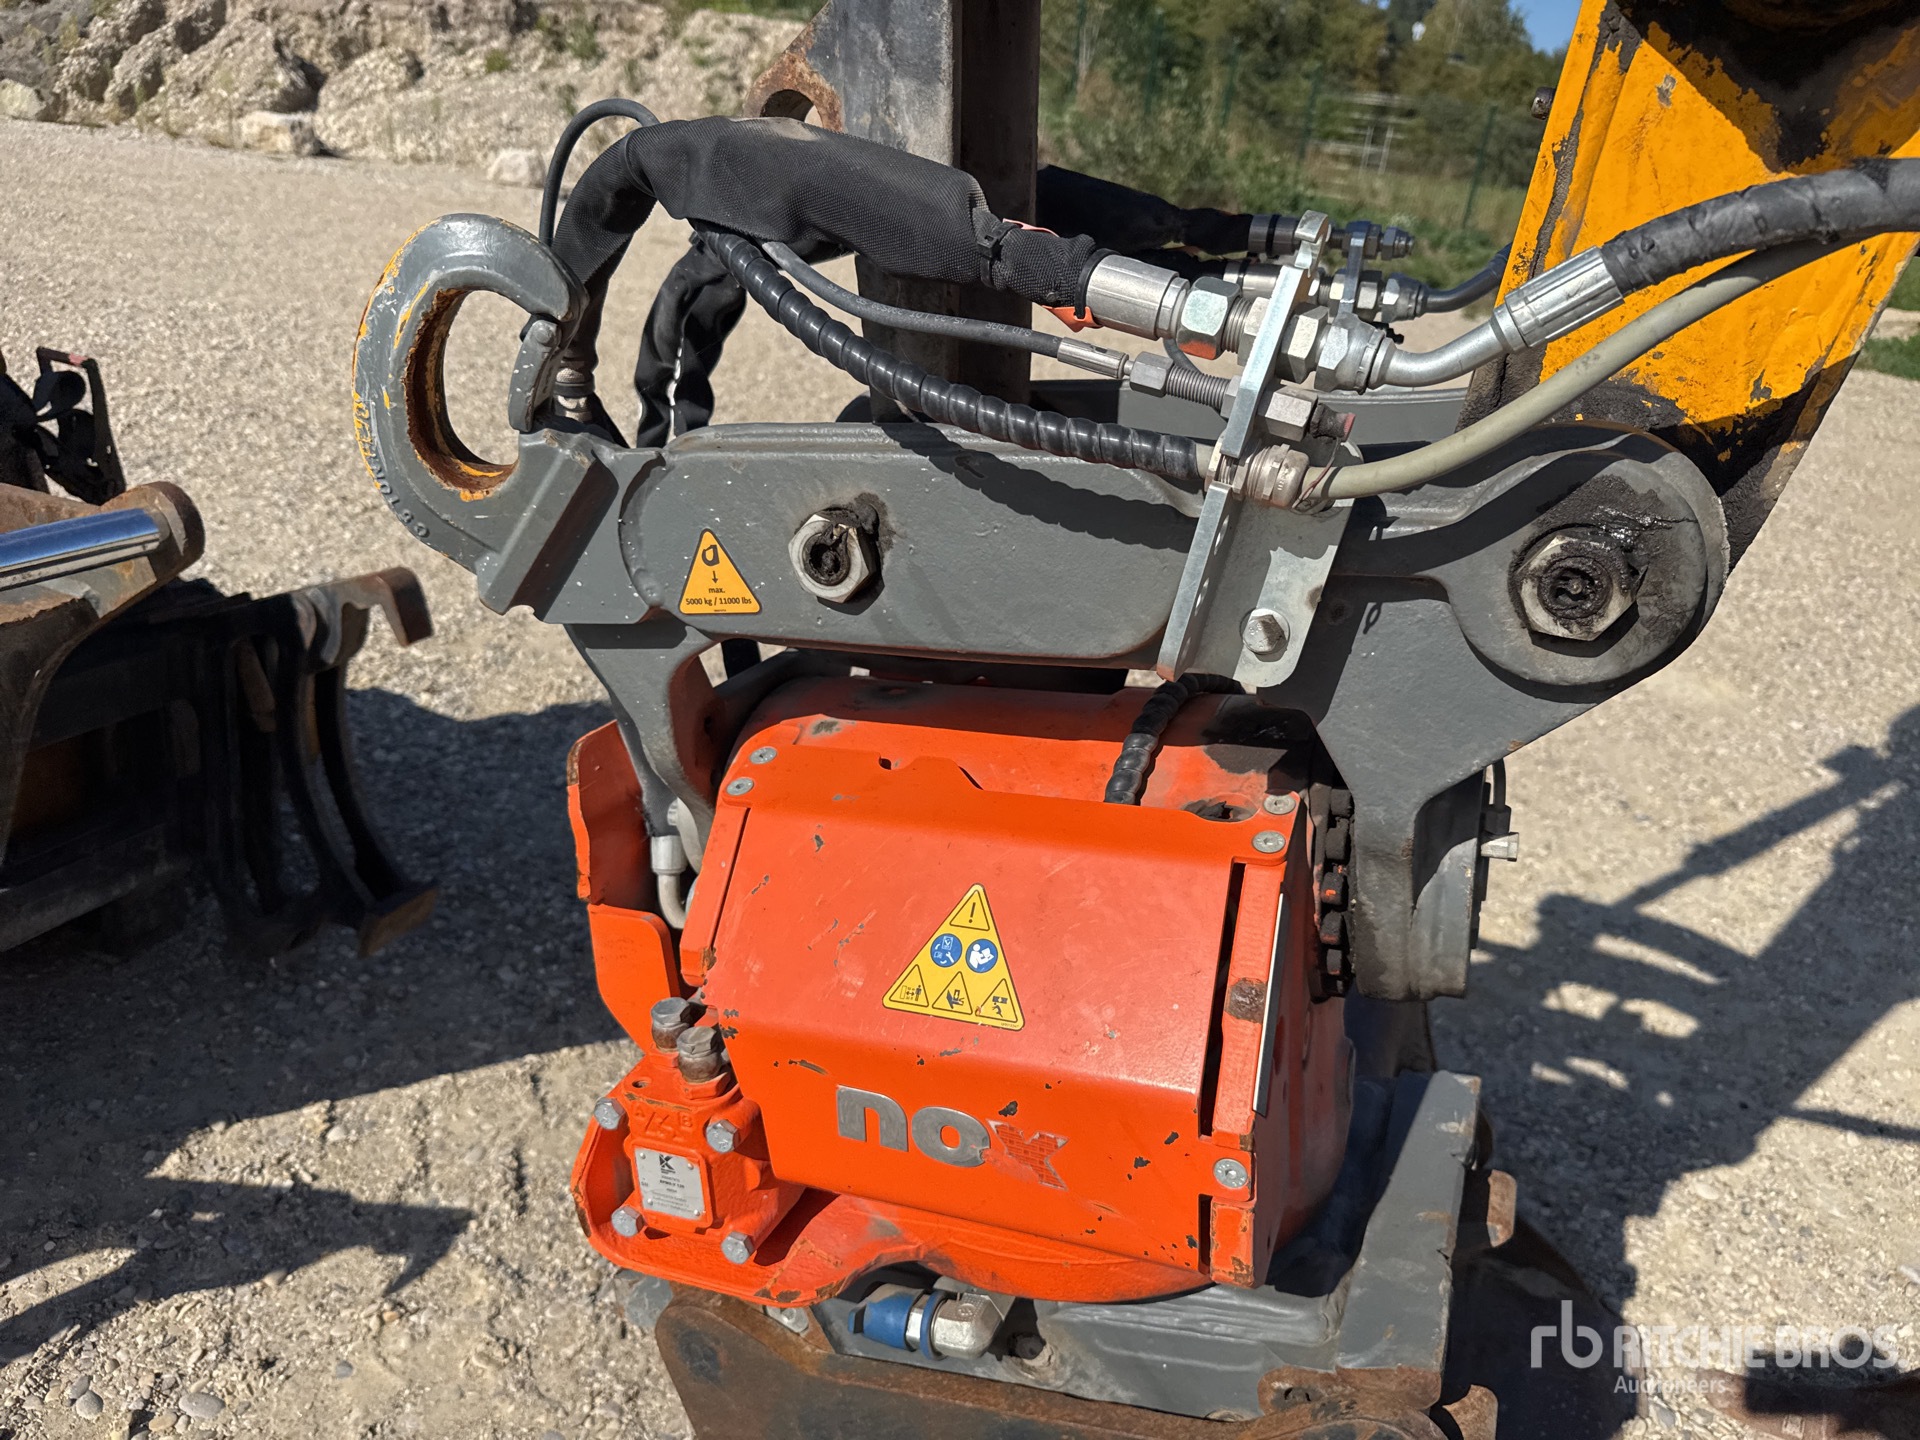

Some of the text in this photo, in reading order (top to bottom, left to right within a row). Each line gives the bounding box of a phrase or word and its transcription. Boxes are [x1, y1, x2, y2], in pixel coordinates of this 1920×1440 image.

[704, 597, 713, 607] kg
[719, 597, 741, 605] 11000
[742, 597, 752, 605] lbs
